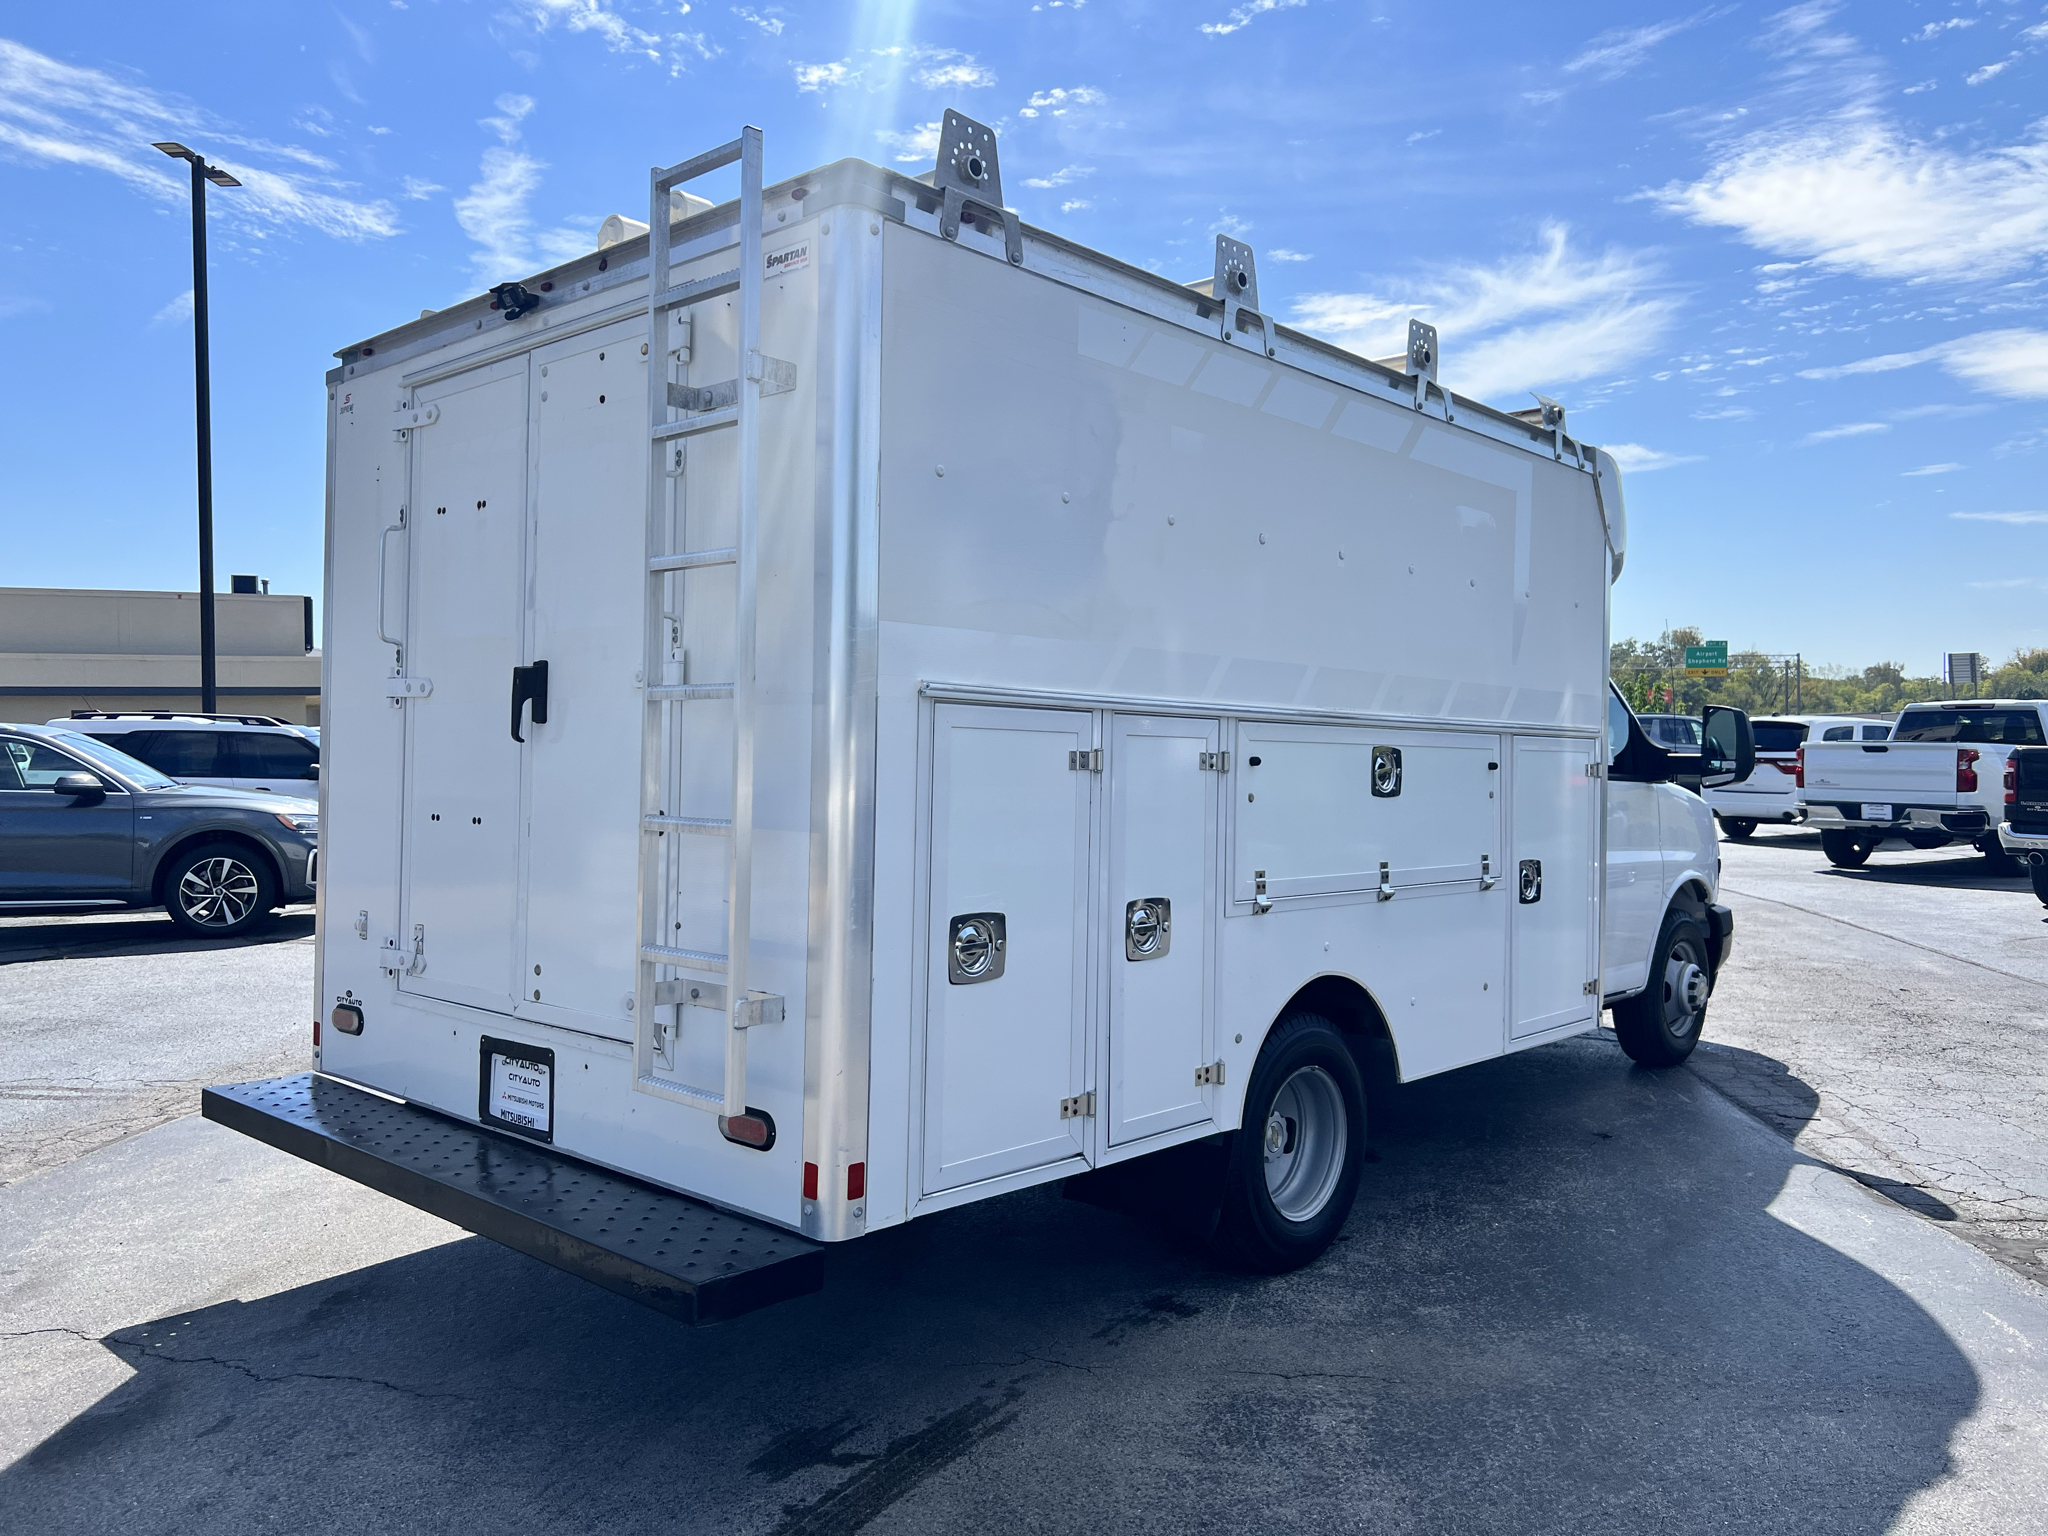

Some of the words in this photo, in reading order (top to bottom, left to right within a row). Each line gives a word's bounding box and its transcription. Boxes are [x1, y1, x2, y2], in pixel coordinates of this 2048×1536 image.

[766, 246, 807, 269] SPARTAN
[336, 996, 362, 1006] CITYAUTO
[508, 1073, 540, 1087] CITYAUTO
[507, 1094, 528, 1105] MITSUBISHI
[528, 1100, 544, 1109] MOTORS
[501, 1109, 534, 1127] MITSUBISHI
